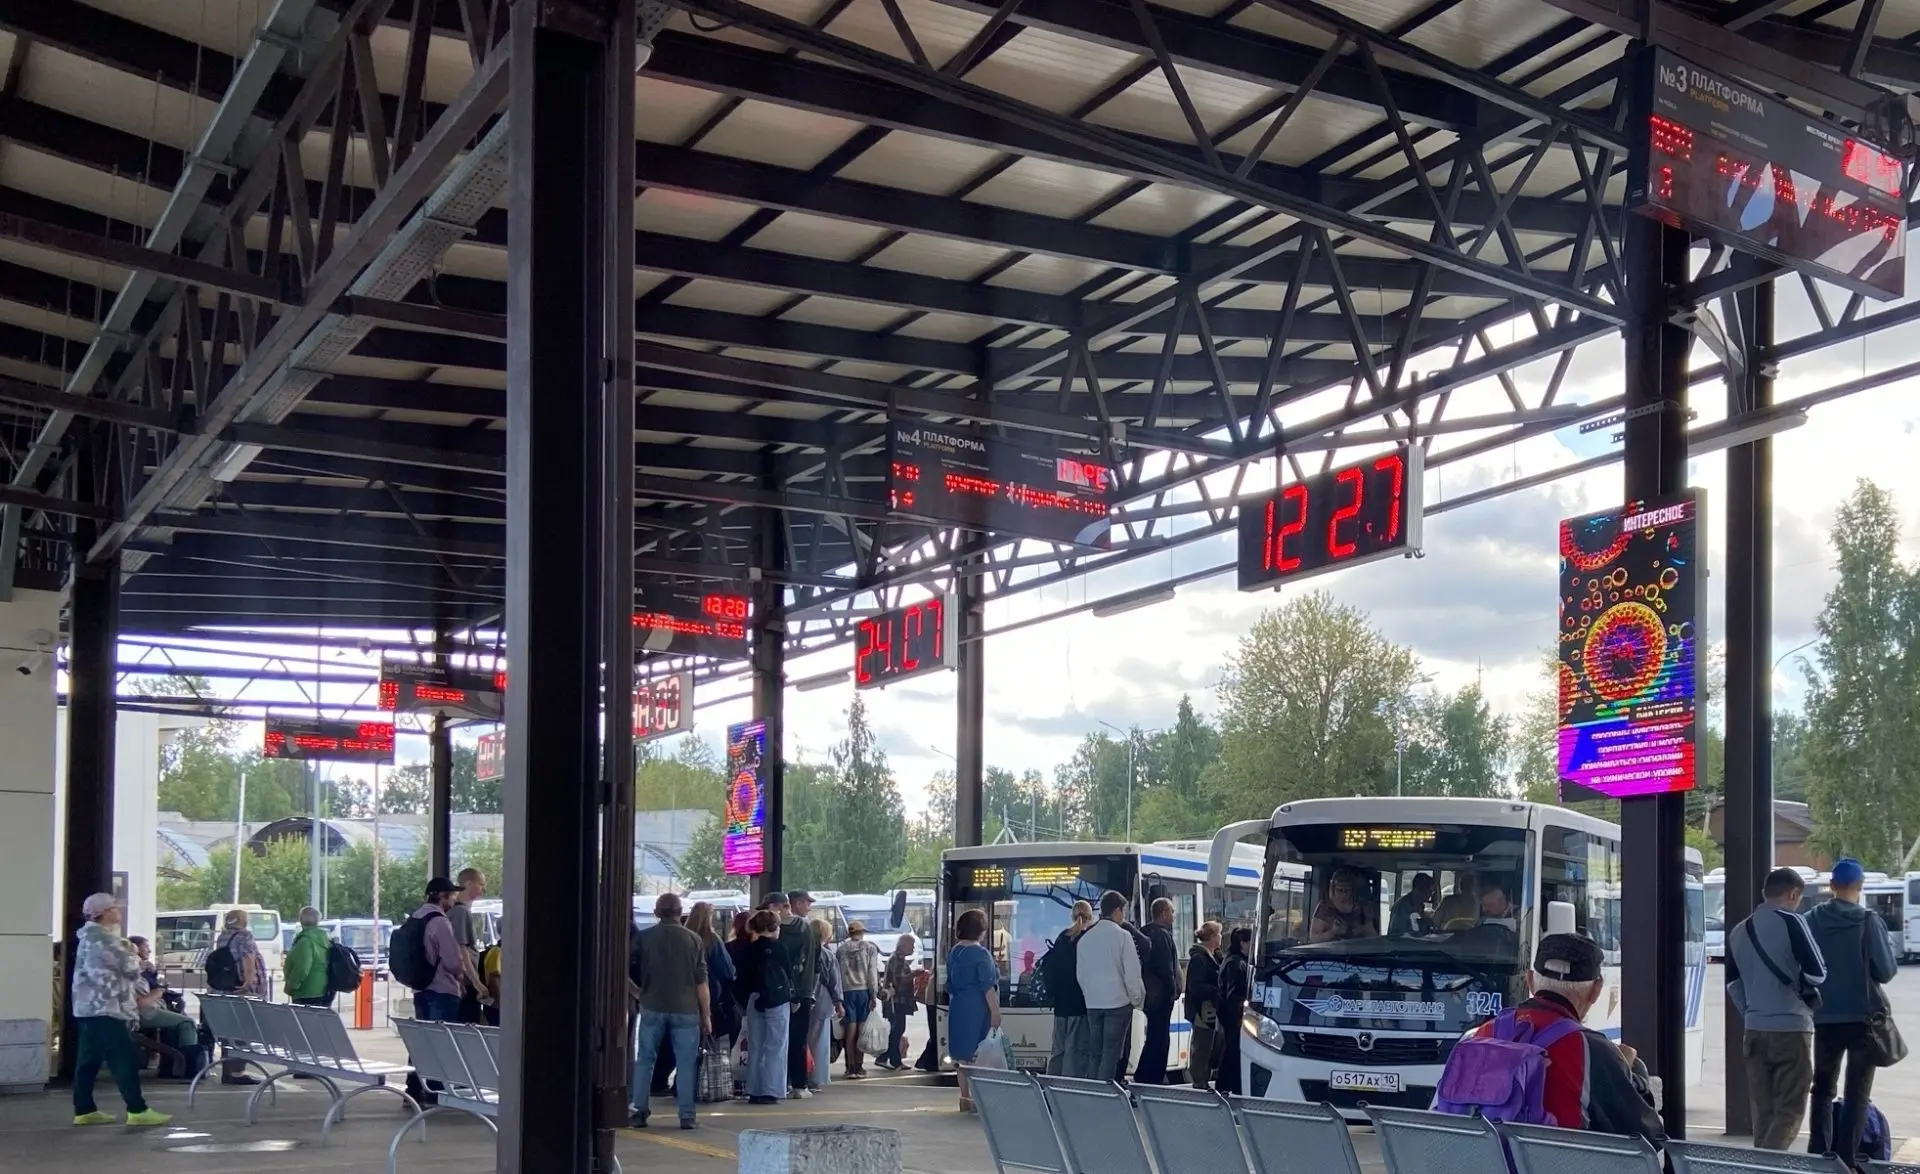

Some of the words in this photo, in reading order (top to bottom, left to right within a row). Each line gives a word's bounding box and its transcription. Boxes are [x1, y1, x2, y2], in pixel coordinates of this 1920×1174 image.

[1690, 71, 1764, 117] ПЛАТФОРМА
[923, 431, 986, 453] ПЛАТФОРМА
[1623, 504, 1684, 533] ИНТЕРЕСНОЕ
[1466, 992, 1502, 1016] 324
